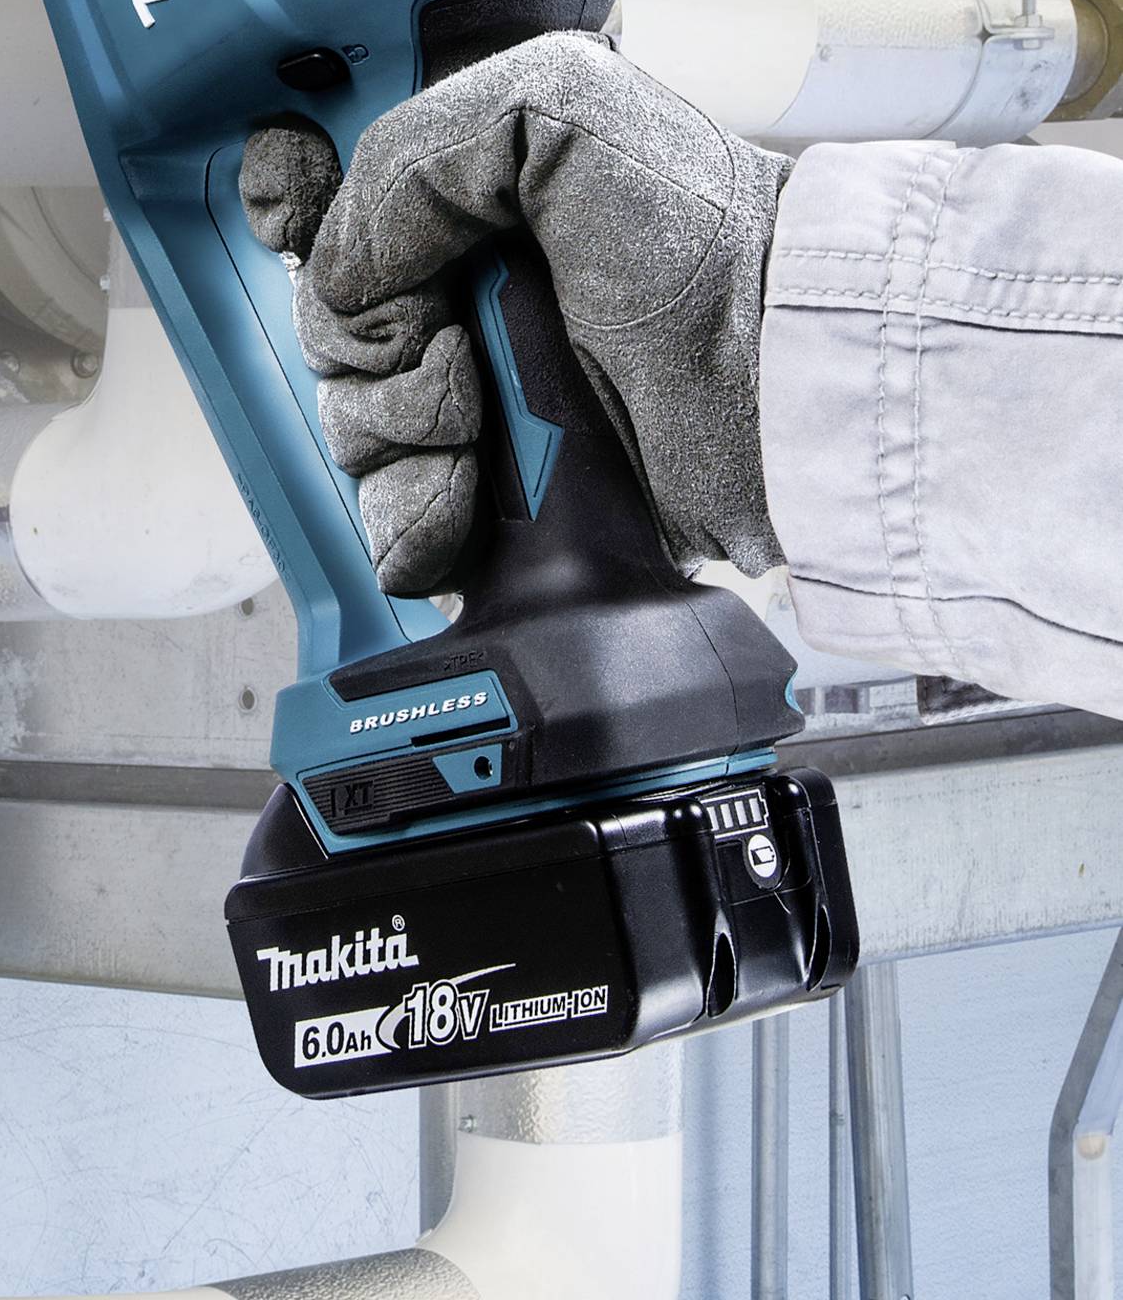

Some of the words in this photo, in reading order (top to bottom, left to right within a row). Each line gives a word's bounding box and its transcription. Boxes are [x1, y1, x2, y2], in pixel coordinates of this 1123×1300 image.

[349, 691, 488, 734] BRUSHLESS
[302, 1021, 372, 1061] 6.0Ah
[490, 985, 609, 1032] LITHIUM-ION
